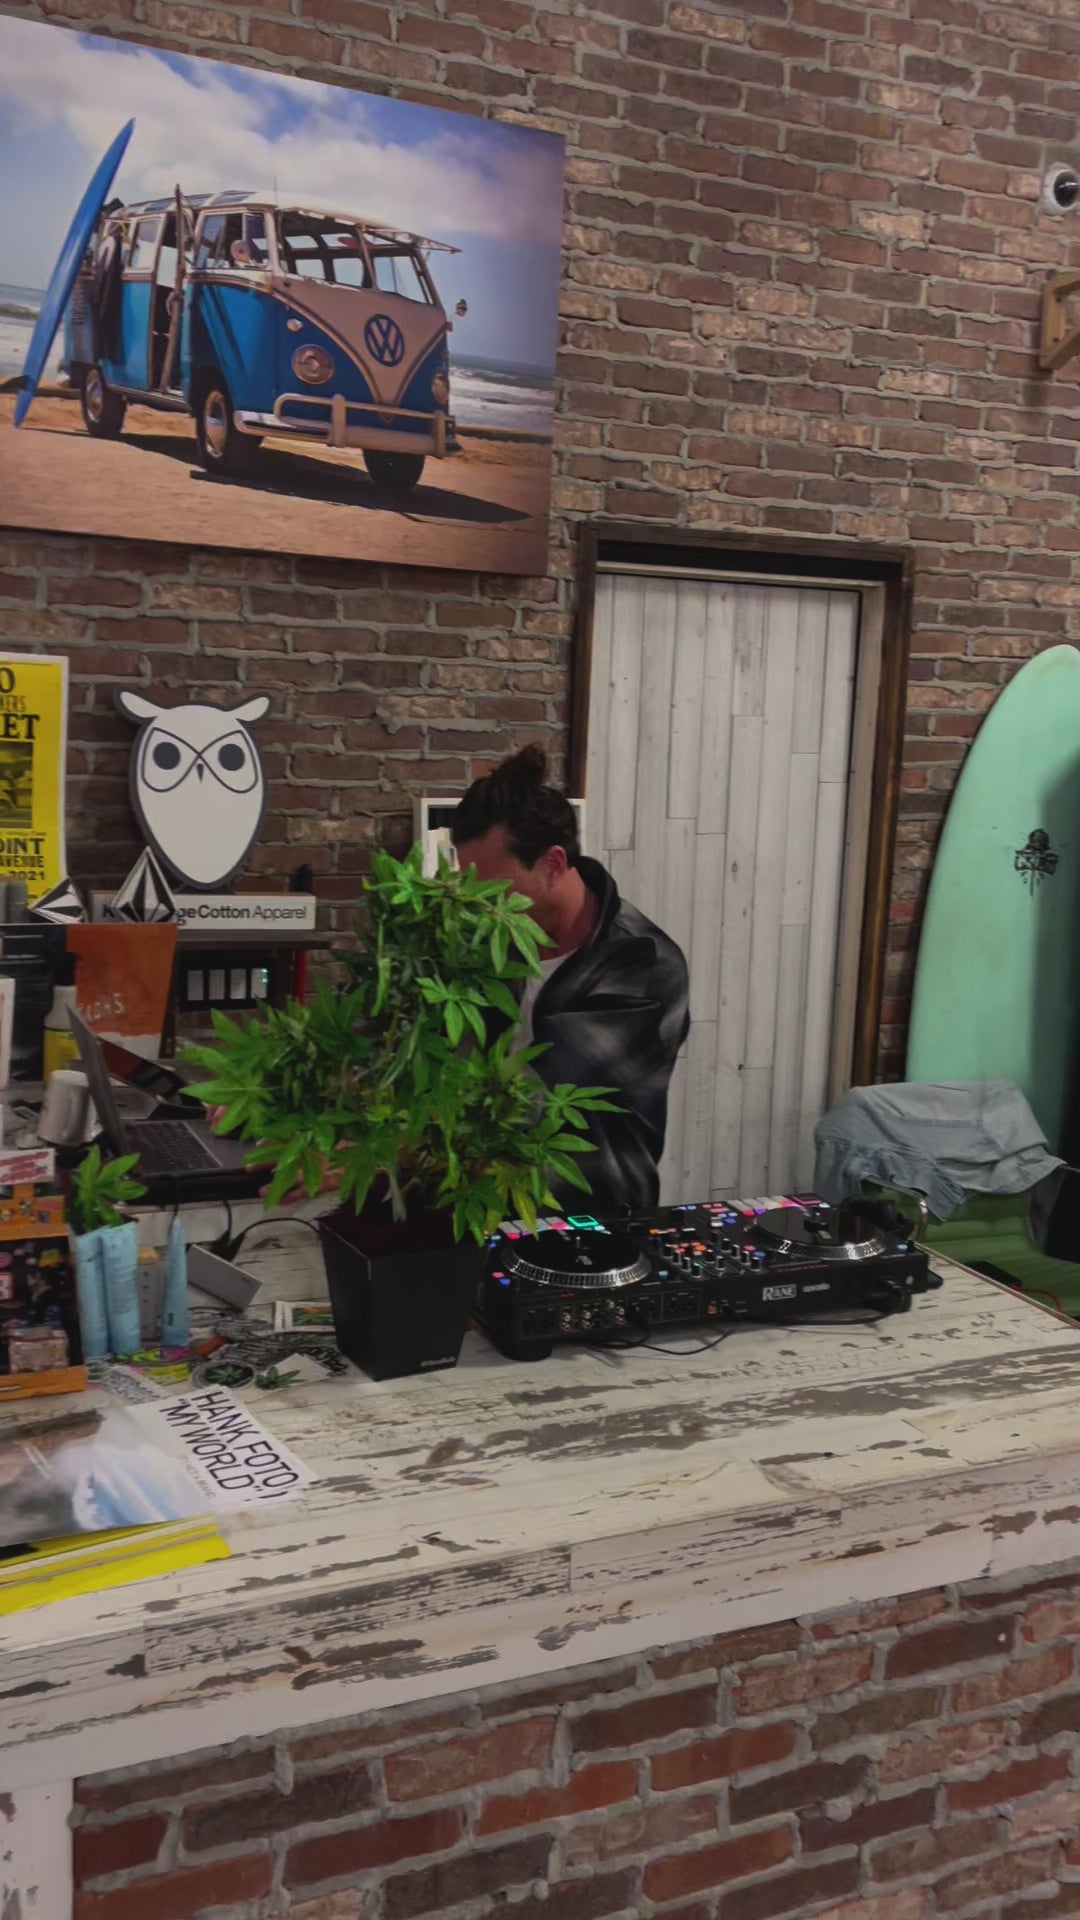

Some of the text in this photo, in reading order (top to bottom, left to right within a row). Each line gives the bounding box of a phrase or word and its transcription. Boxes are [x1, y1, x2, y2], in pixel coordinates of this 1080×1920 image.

[0, 712, 40, 739] ET
[252, 905, 307, 921] Apparel
[159, 1398, 207, 1427] "MY
[191, 1391, 260, 1443] HANK
[234, 1441, 299, 1488] FOTO
[180, 1427, 264, 1491] WORLD"
